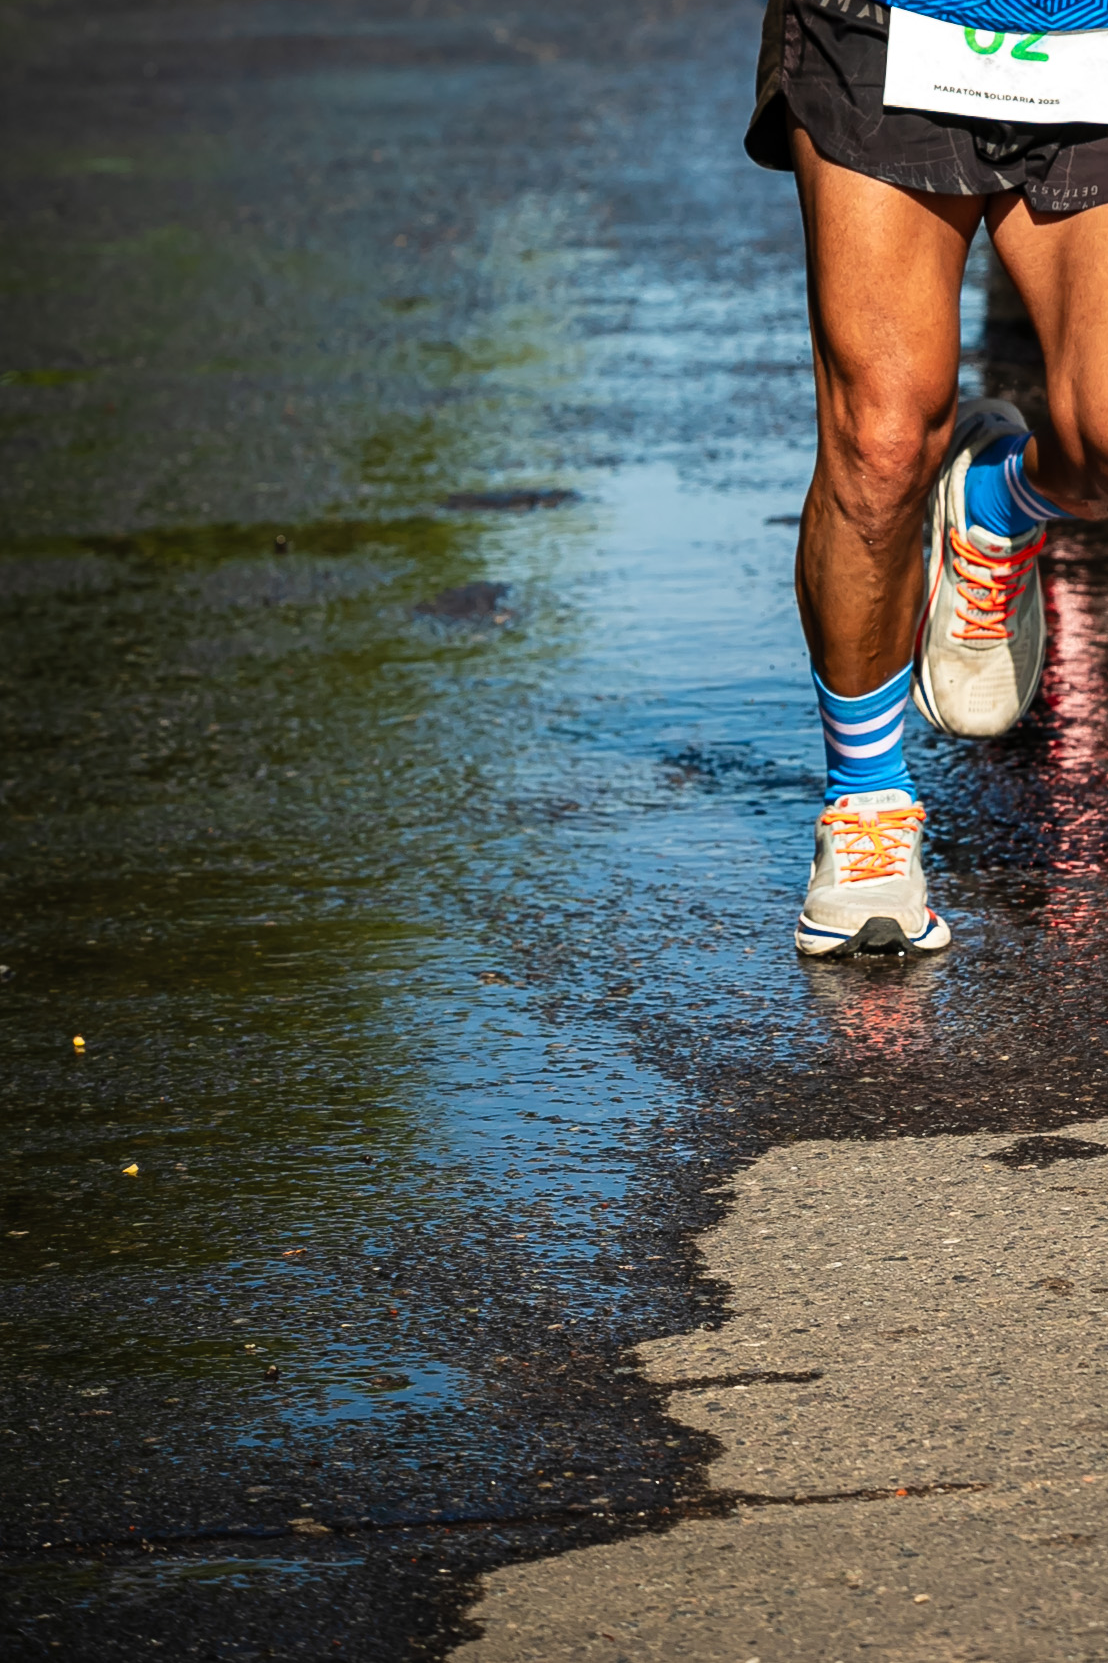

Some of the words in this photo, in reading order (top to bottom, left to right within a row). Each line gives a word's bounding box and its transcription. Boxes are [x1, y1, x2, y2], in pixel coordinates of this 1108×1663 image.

[933, 84, 982, 98] MARATON
[984, 92, 1036, 105] SOLIDARIA
[1038, 98, 1061, 106] 2025
